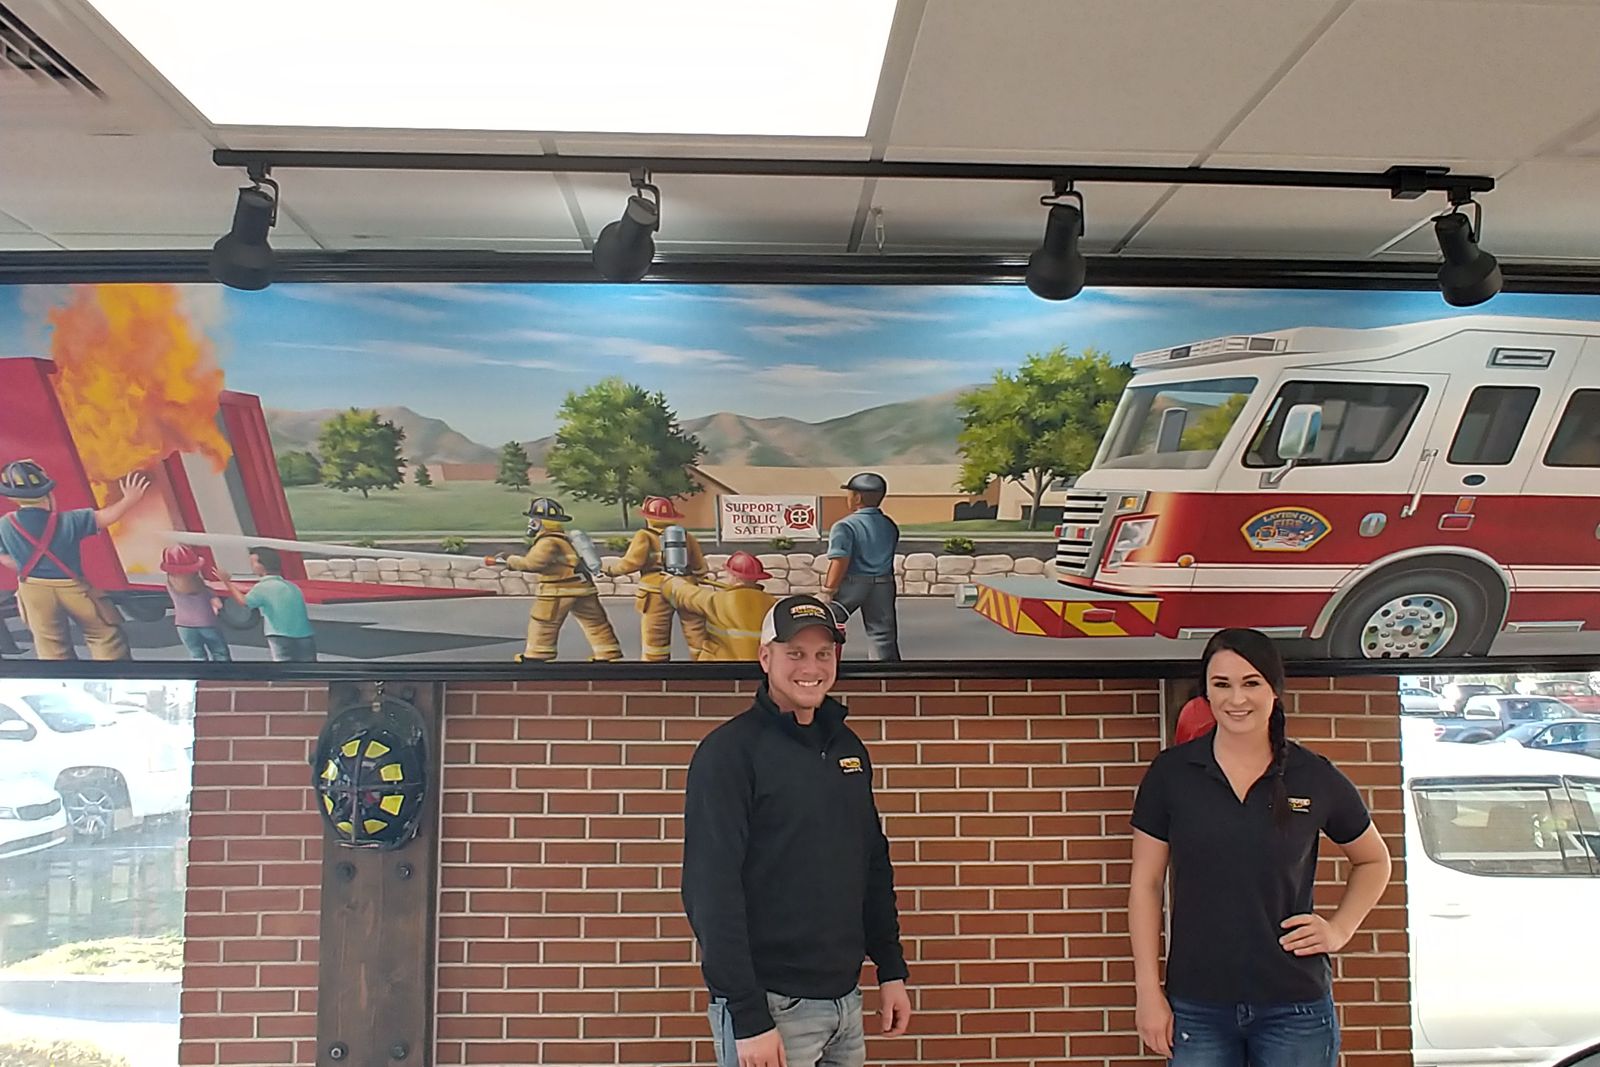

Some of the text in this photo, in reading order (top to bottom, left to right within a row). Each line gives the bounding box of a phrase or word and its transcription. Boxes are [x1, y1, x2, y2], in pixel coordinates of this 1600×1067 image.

[725, 503, 783, 512] SUPPORT
[732, 515, 777, 524] PUBLIC
[1273, 519, 1304, 527] FIRE
[1299, 513, 1318, 524] CITY
[734, 526, 784, 534] SAFETY
